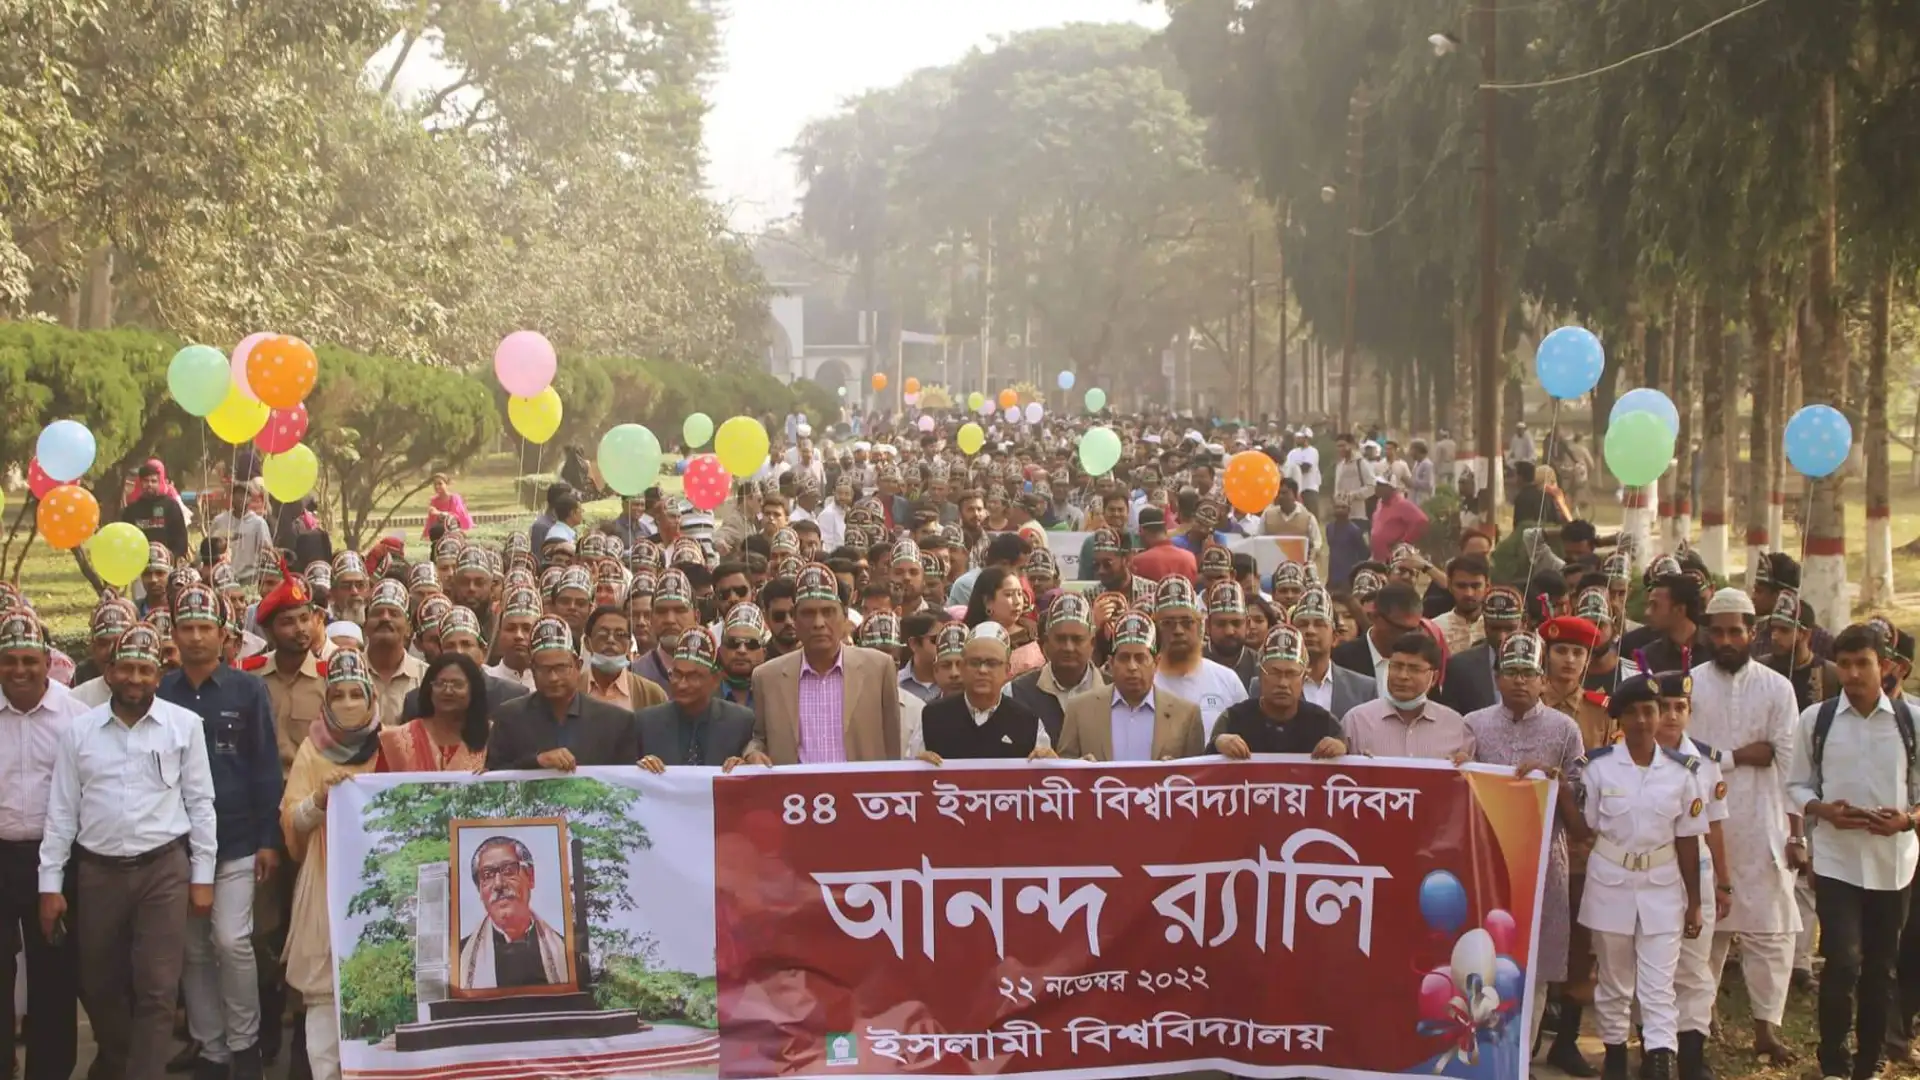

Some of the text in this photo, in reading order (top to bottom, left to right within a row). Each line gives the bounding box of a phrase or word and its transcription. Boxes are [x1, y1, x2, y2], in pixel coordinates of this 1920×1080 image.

[783, 774, 1421, 826] ৪৪ তম ইসলামী বিশ্ববিদ্যালয় দিবস
[810, 854, 1122, 962] আনন্দ
[999, 966, 1209, 1004] ২২ নভেম্বর ২০২২
[865, 1011, 1334, 1064] ইসলামী বিশ্ববিদ্যালয়
